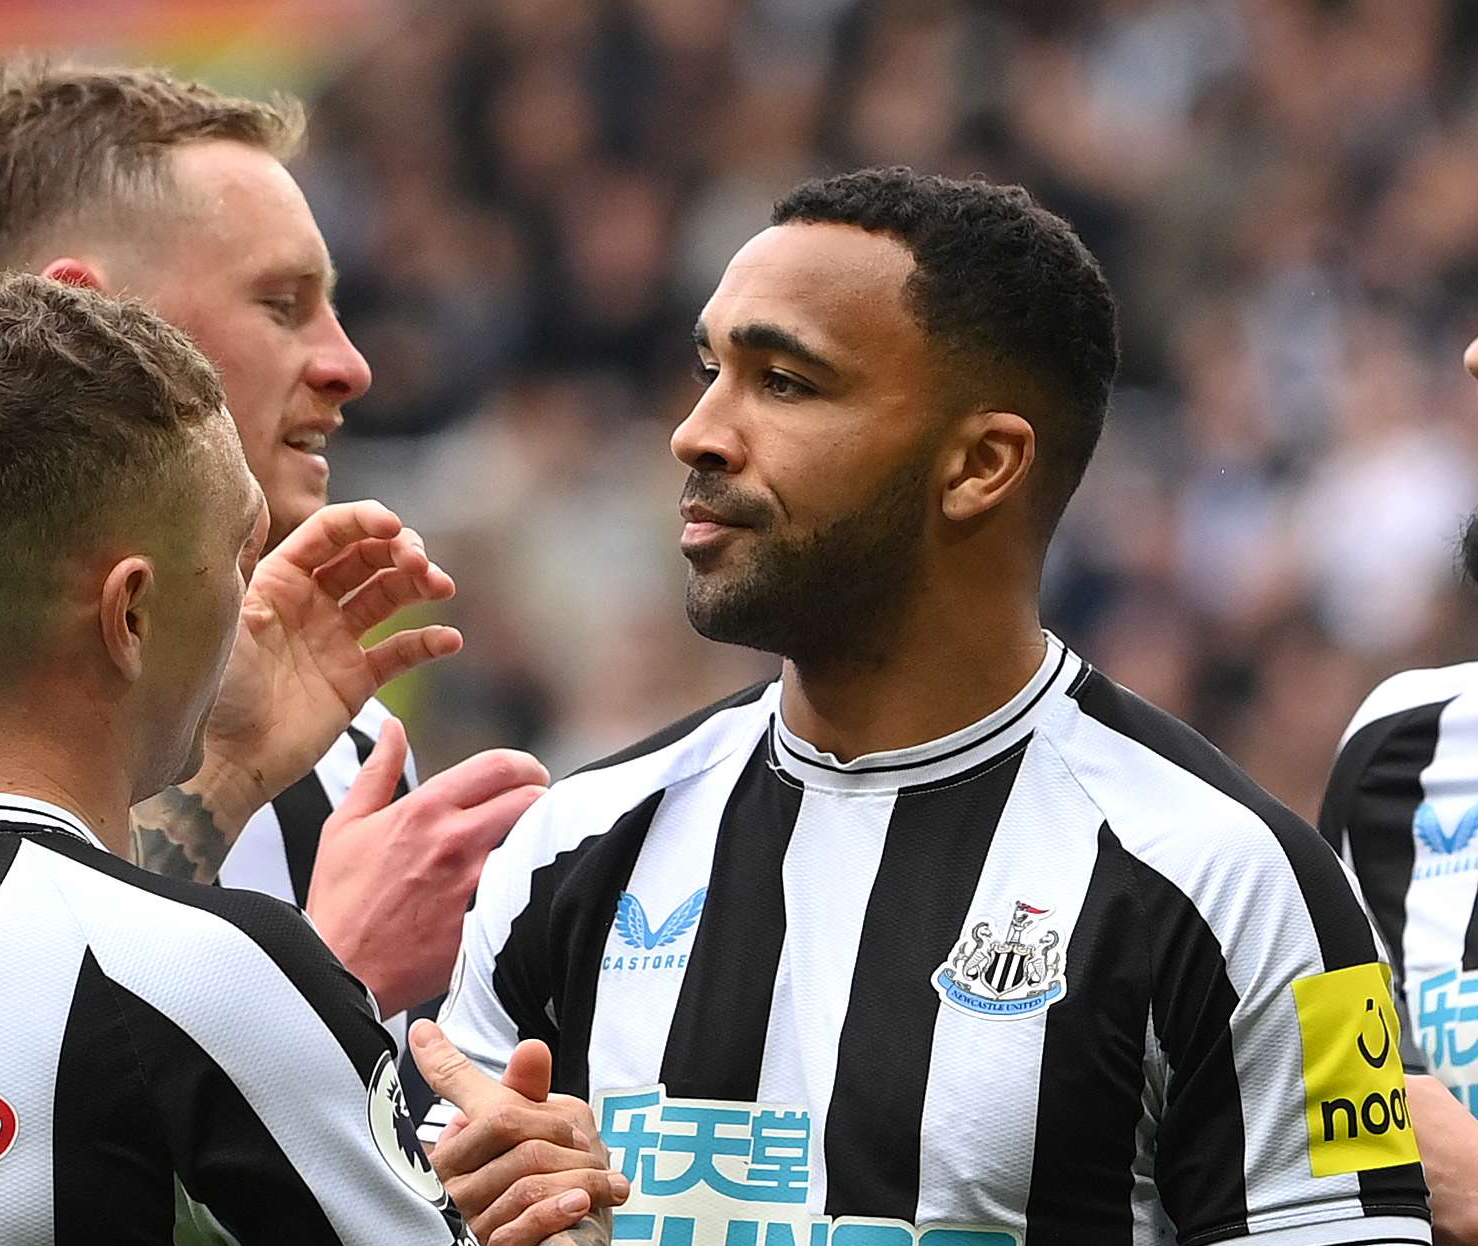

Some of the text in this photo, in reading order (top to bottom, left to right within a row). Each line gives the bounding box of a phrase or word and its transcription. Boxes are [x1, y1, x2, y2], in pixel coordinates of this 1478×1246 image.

[603, 955, 688, 970] CASTORE
[951, 989, 1042, 1011] NEWCASTLE UNITED
[601, 1091, 811, 1204] 乐天堂
